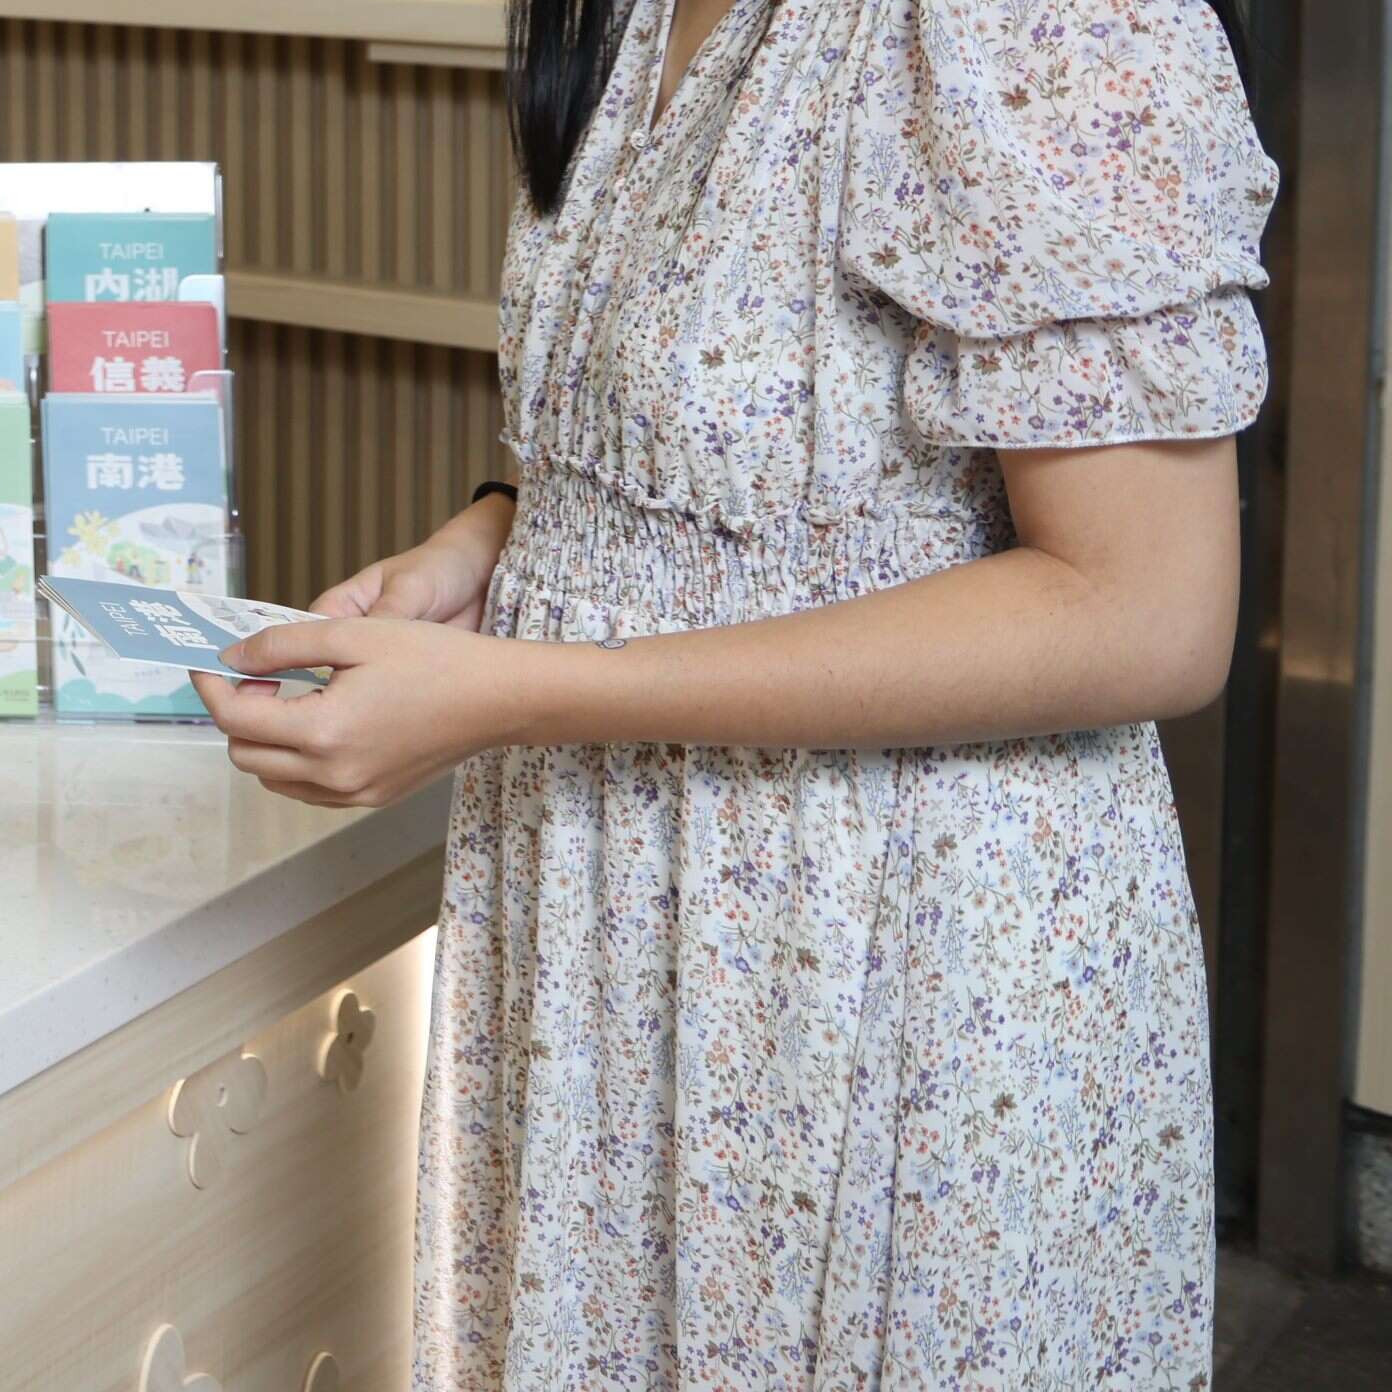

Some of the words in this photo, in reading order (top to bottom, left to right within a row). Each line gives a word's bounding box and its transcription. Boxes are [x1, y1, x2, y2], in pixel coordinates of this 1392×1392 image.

[99, 243, 164, 260] TAIPEI
[102, 330, 170, 349] TAIPEI
[89, 356, 186, 393] 信義
[100, 427, 169, 446] TAIPEI
[86, 452, 186, 491] 南港
[99, 601, 149, 637] TAIPEI
[128, 599, 220, 651] 南港
